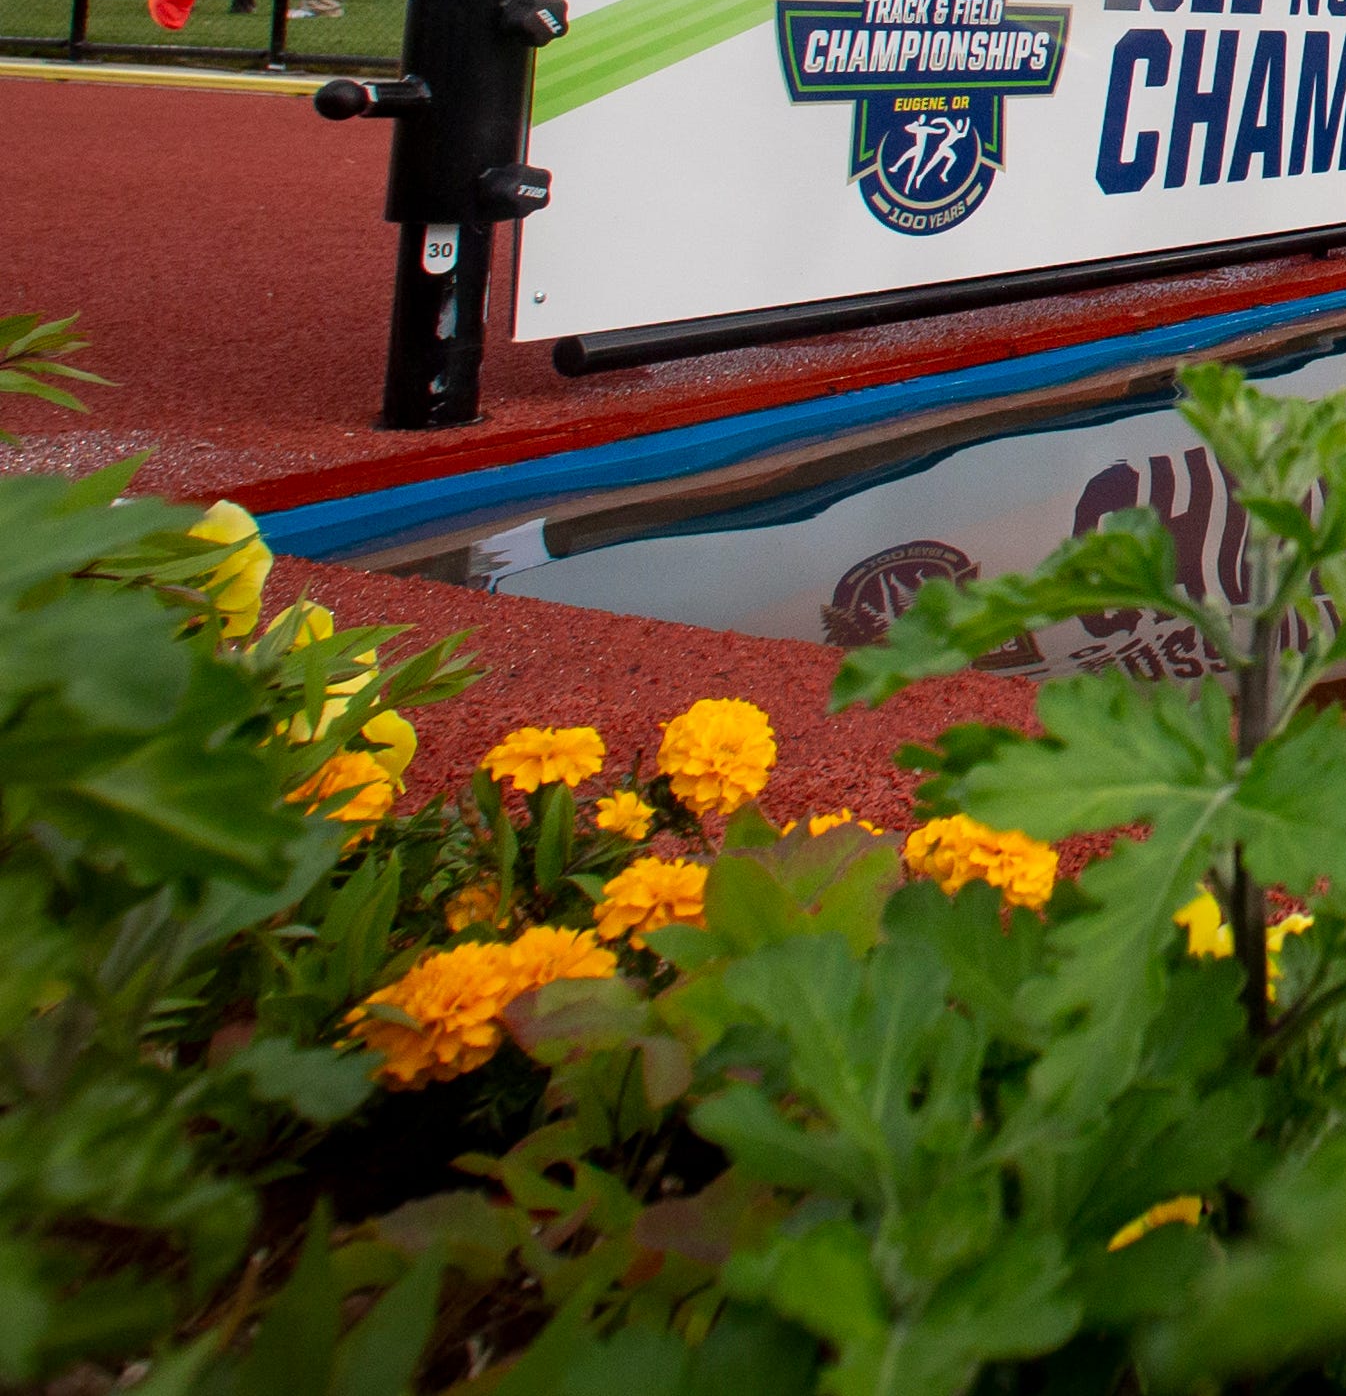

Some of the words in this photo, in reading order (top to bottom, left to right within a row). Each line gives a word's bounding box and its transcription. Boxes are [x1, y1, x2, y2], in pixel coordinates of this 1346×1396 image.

[537, 8, 562, 34] GILL
[804, 30, 1048, 73] CHAMPIONSHIPS
[894, 97, 948, 112] EUGENE,
[951, 95, 970, 109] OR
[888, 207, 927, 229] 100
[928, 201, 965, 229] YEARS
[428, 242, 453, 258] 30
